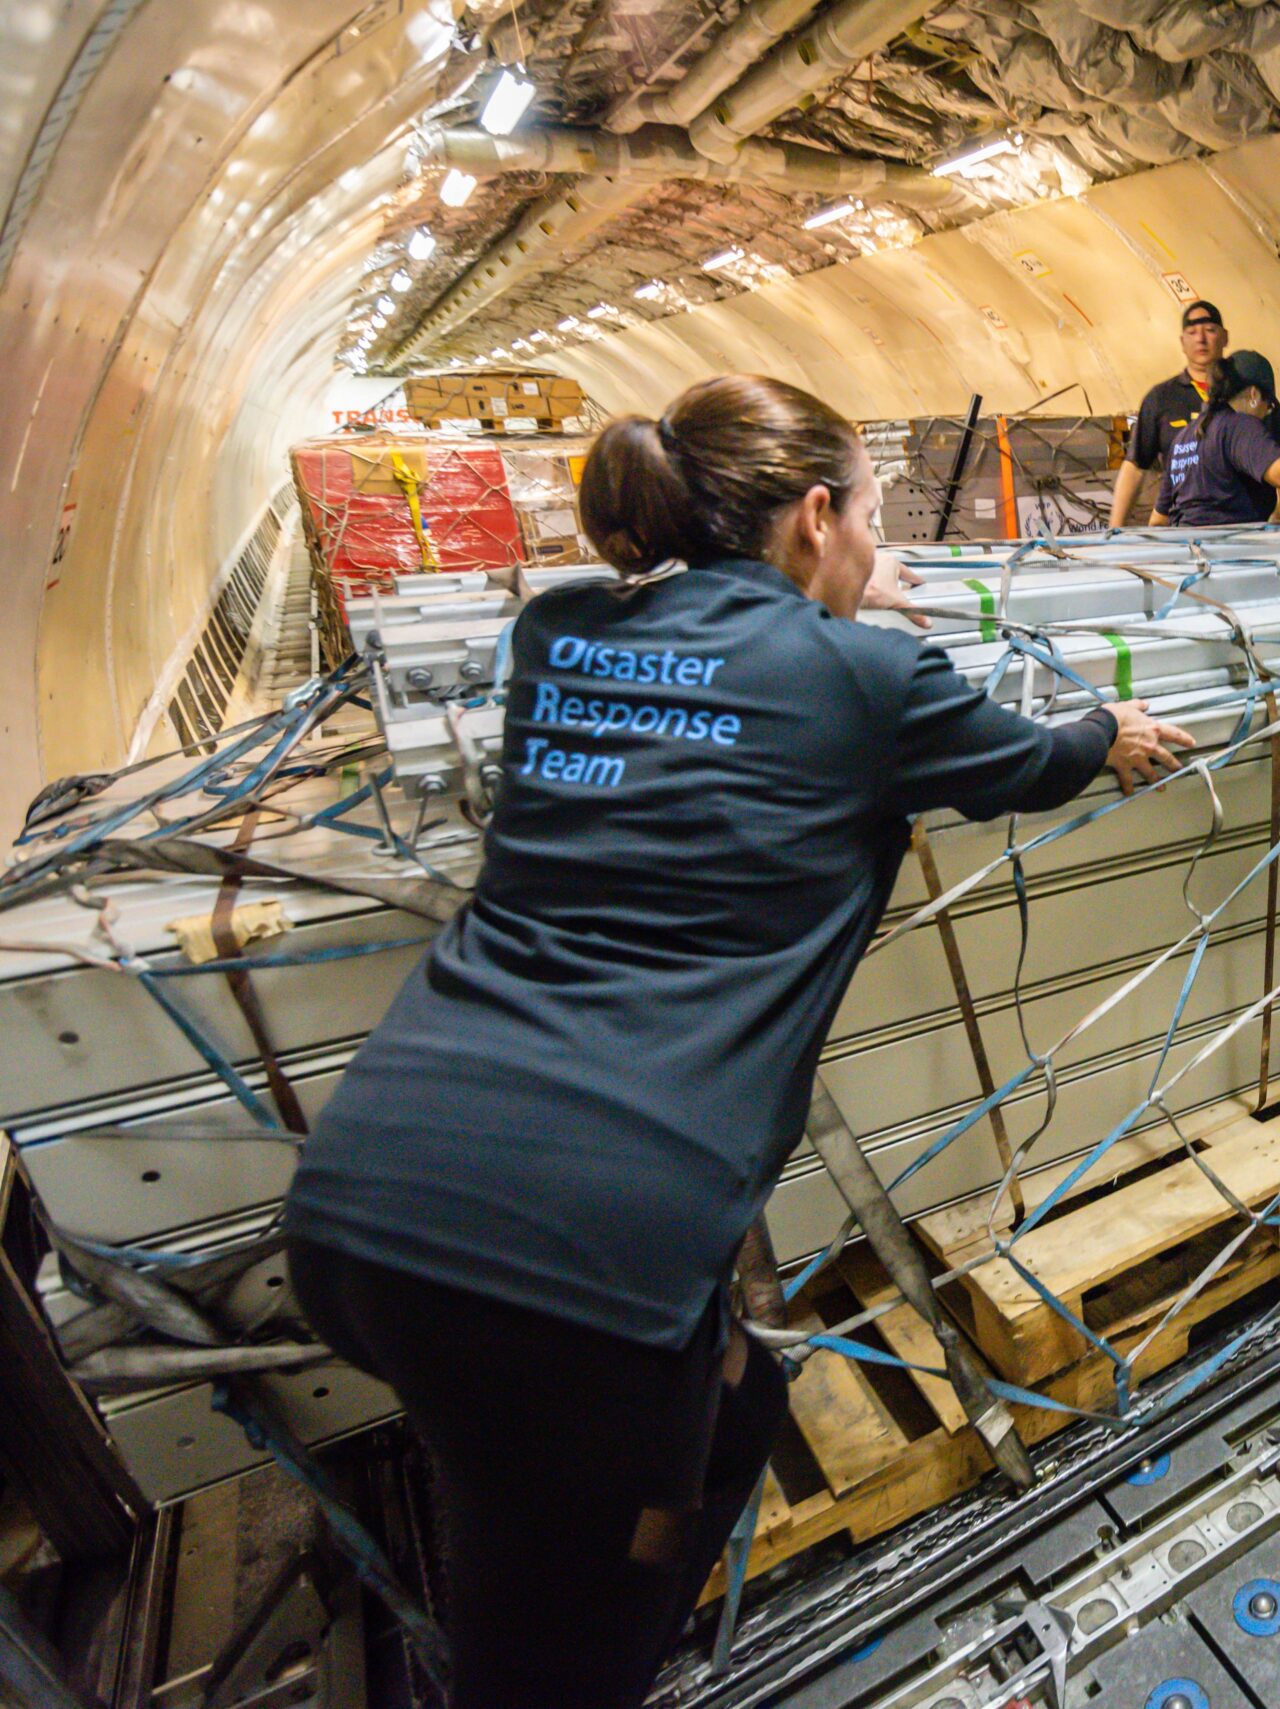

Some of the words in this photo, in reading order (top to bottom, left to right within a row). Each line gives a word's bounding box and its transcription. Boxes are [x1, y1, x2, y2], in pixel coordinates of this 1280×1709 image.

[1171, 279, 1190, 293] 3C
[332, 408, 421, 425] TRANS
[1069, 519, 1097, 533] World
[549, 635, 725, 687] Disaster
[532, 681, 742, 746] Response
[520, 736, 627, 788] Team
